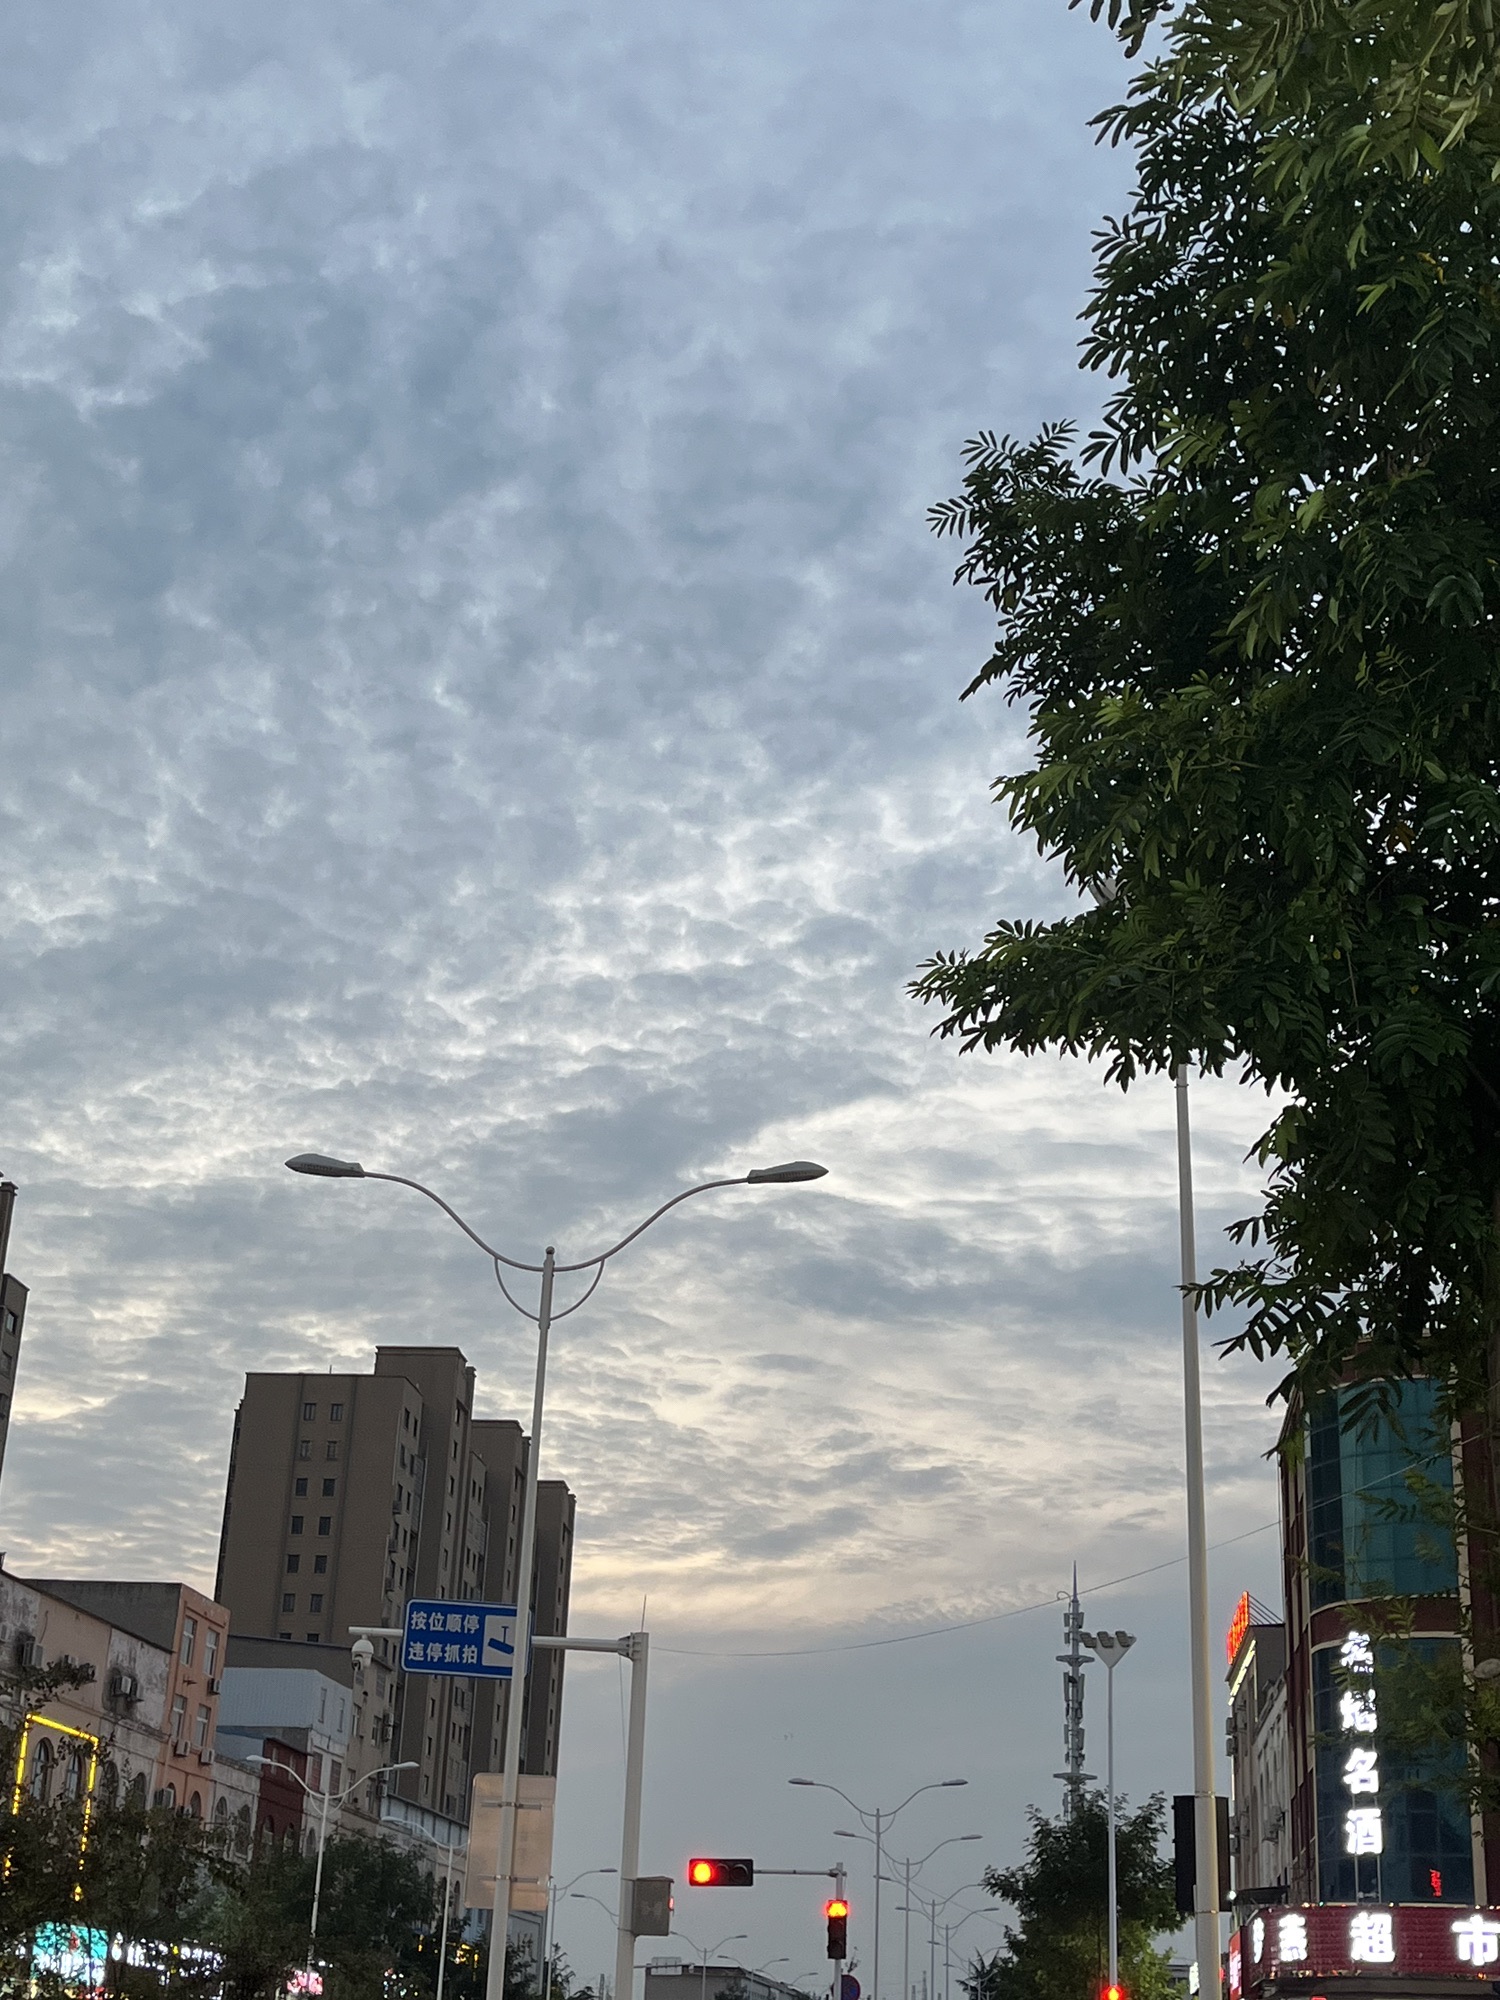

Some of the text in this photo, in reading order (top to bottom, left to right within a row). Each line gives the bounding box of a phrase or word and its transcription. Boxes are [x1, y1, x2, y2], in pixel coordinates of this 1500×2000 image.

[411, 1611, 480, 1634] 按位顺停
[408, 1641, 478, 1664] 违停抓拍
